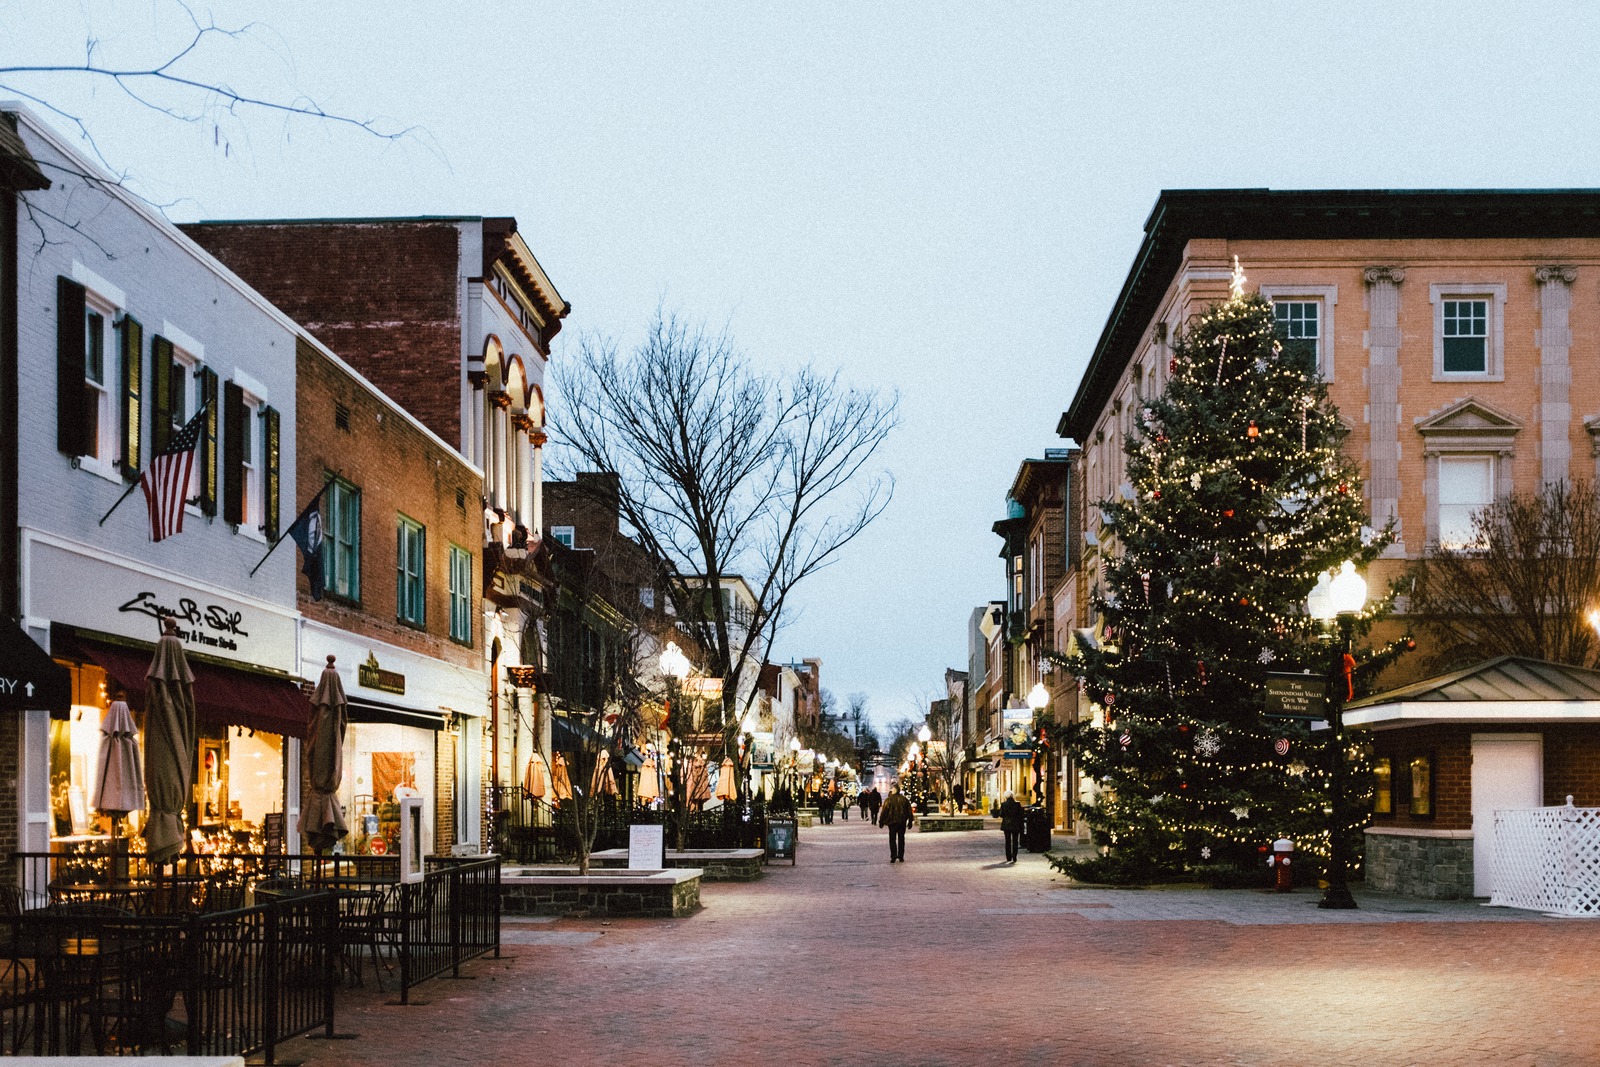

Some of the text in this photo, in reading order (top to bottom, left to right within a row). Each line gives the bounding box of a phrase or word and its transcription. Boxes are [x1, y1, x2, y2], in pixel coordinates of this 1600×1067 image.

[191, 629, 198, 642] &
[198, 631, 218, 648] Frame
[218, 636, 237, 651] Studio
[1269, 689, 1304, 697] SHENANDOAH
[1283, 703, 1307, 711] MUSEUM
